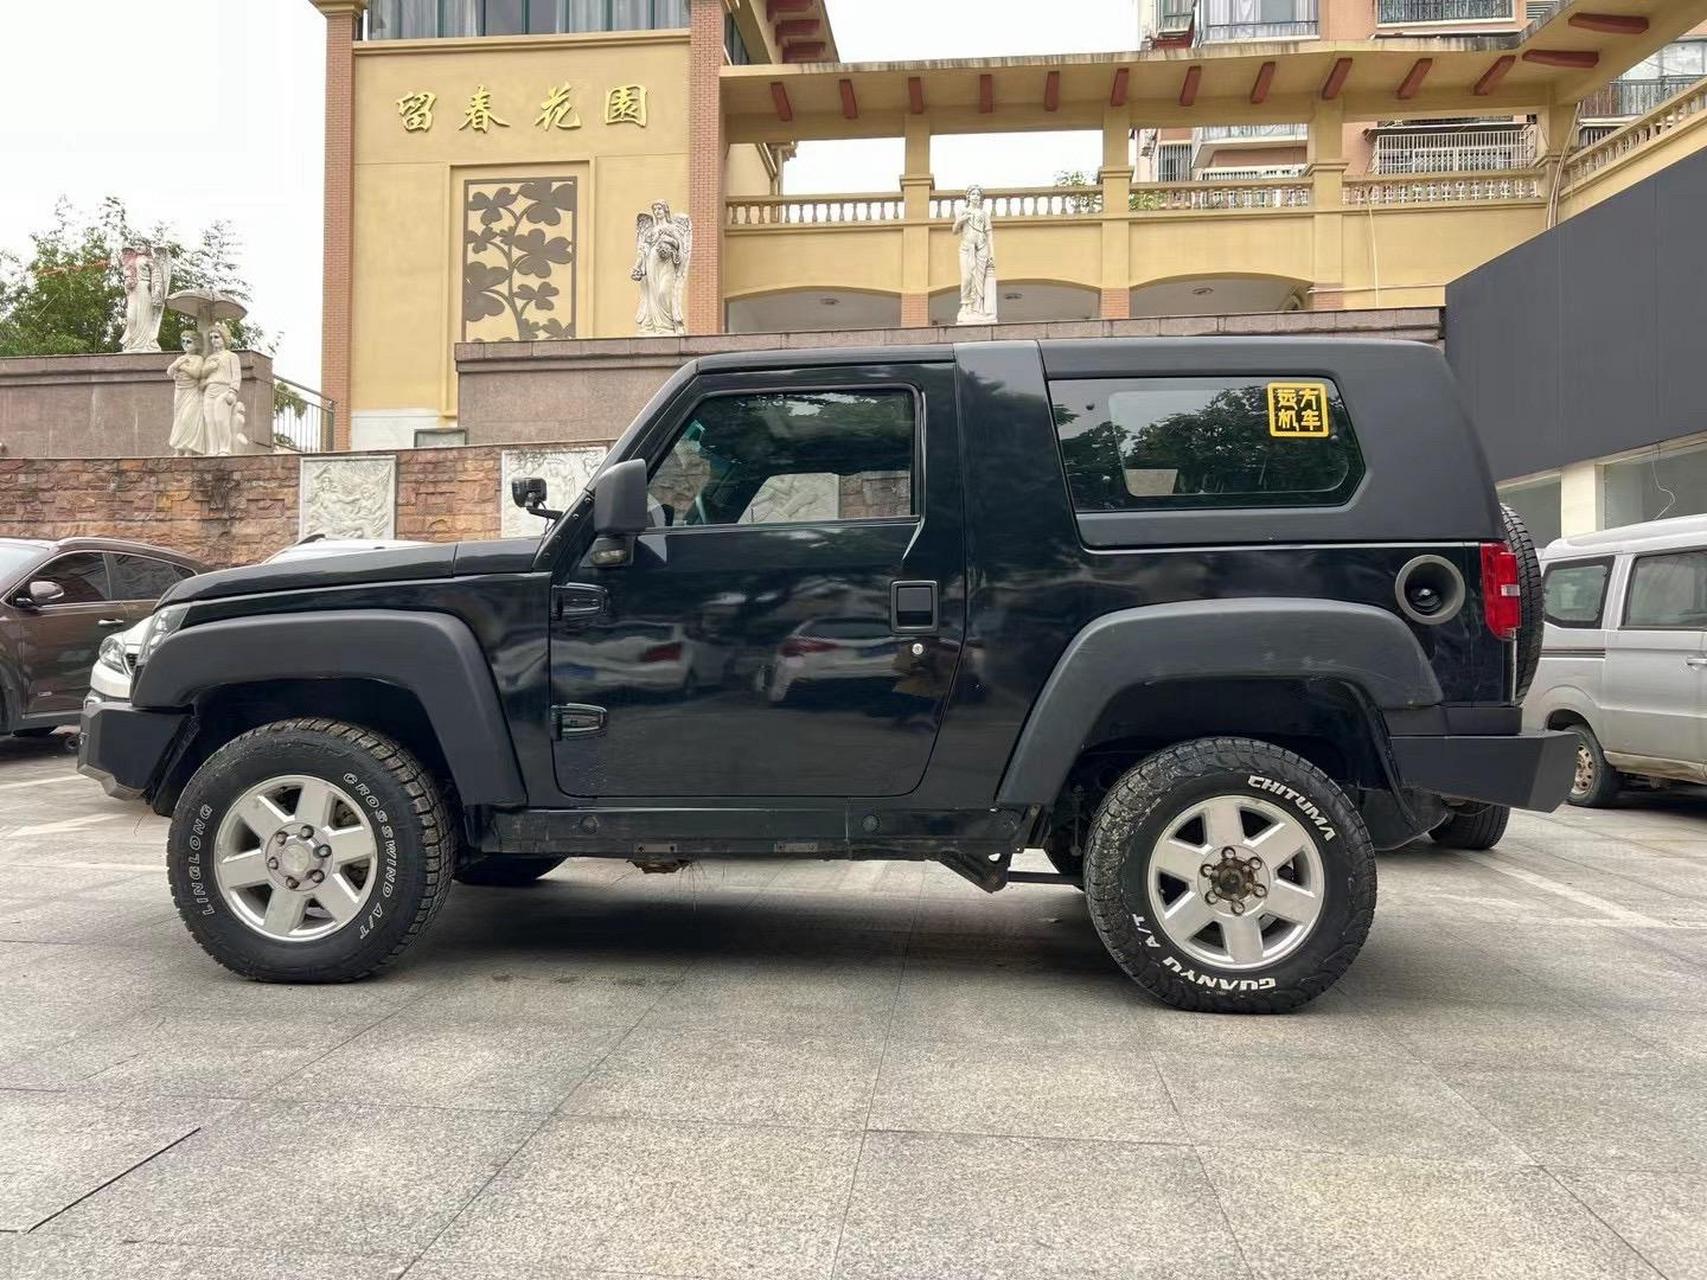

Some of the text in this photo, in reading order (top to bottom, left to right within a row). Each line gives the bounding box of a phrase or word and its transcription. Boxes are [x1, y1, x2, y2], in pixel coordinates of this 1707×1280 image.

[1278, 409, 1321, 432] 机车
[1248, 774, 1336, 842] CHITUMA
[188, 804, 215, 916] LINGLONG
[342, 771, 398, 940] CROSSWIND A/T
[1132, 913, 1277, 991] GUANYU A/T
